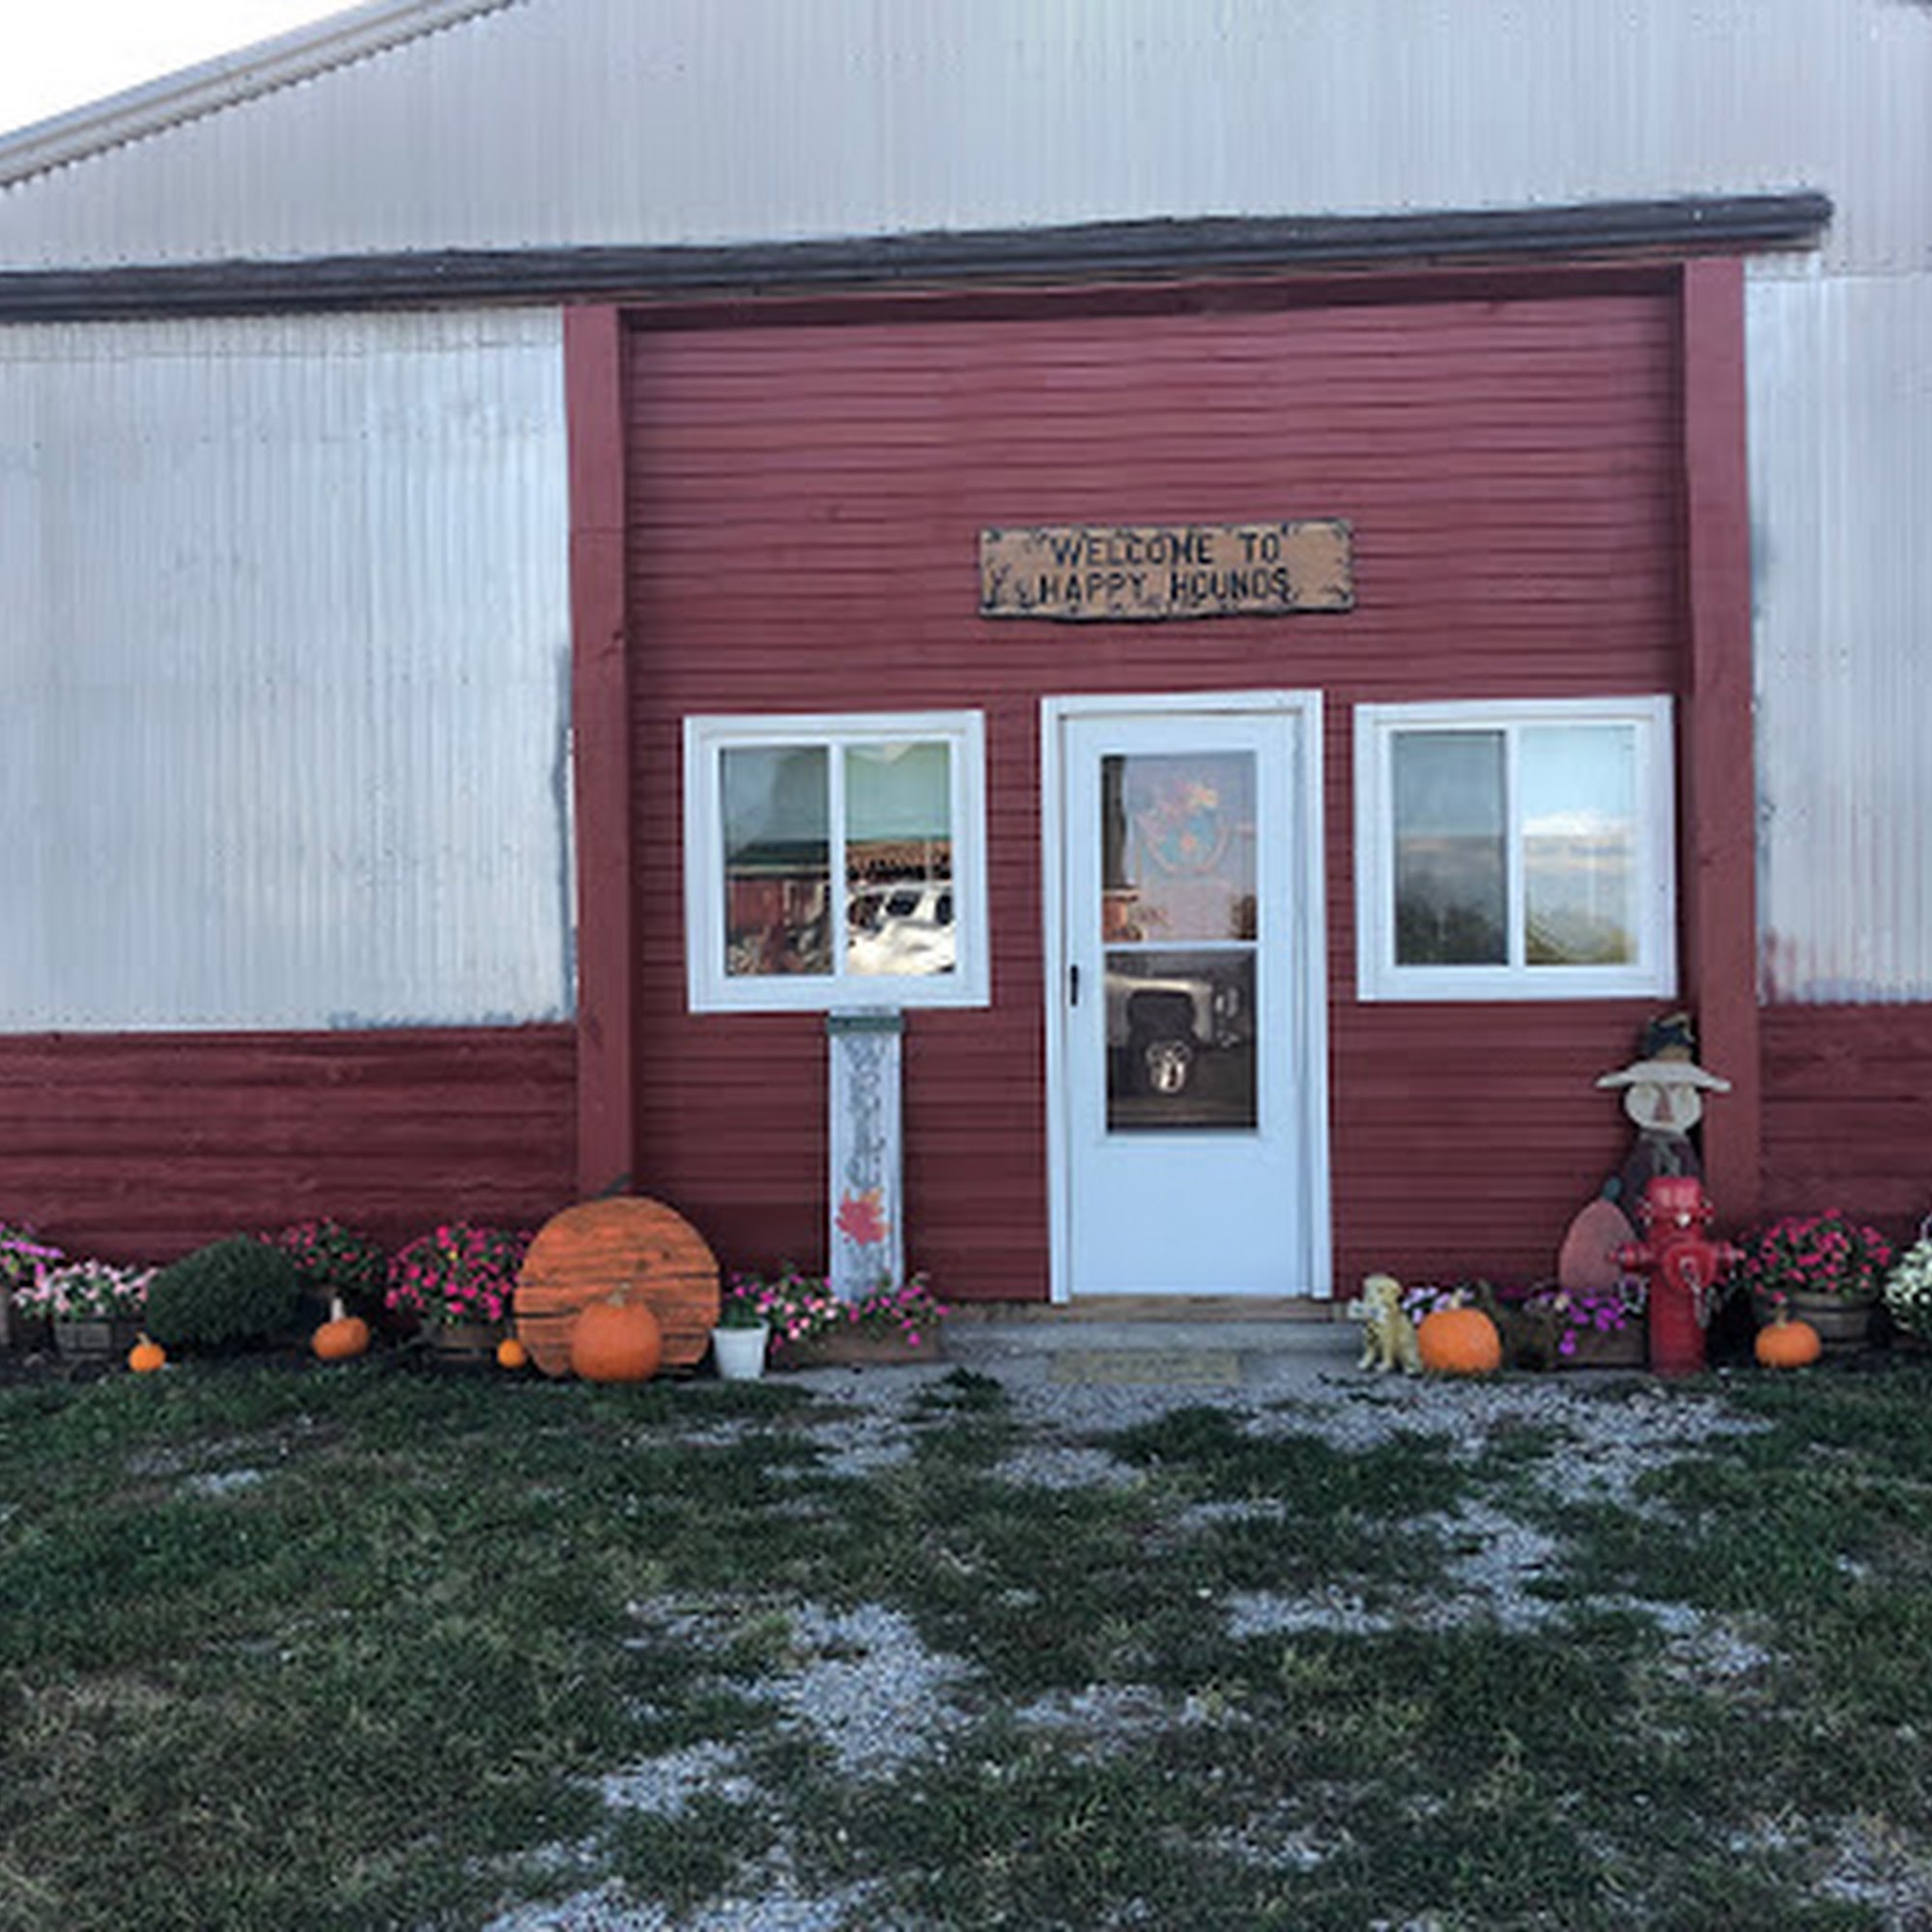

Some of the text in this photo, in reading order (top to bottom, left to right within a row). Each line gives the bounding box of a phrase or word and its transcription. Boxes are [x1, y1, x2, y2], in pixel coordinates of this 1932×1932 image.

[1050, 532, 1280, 566] WELCOME TO
[1039, 567, 1290, 604] HAPPY HOUNDS
